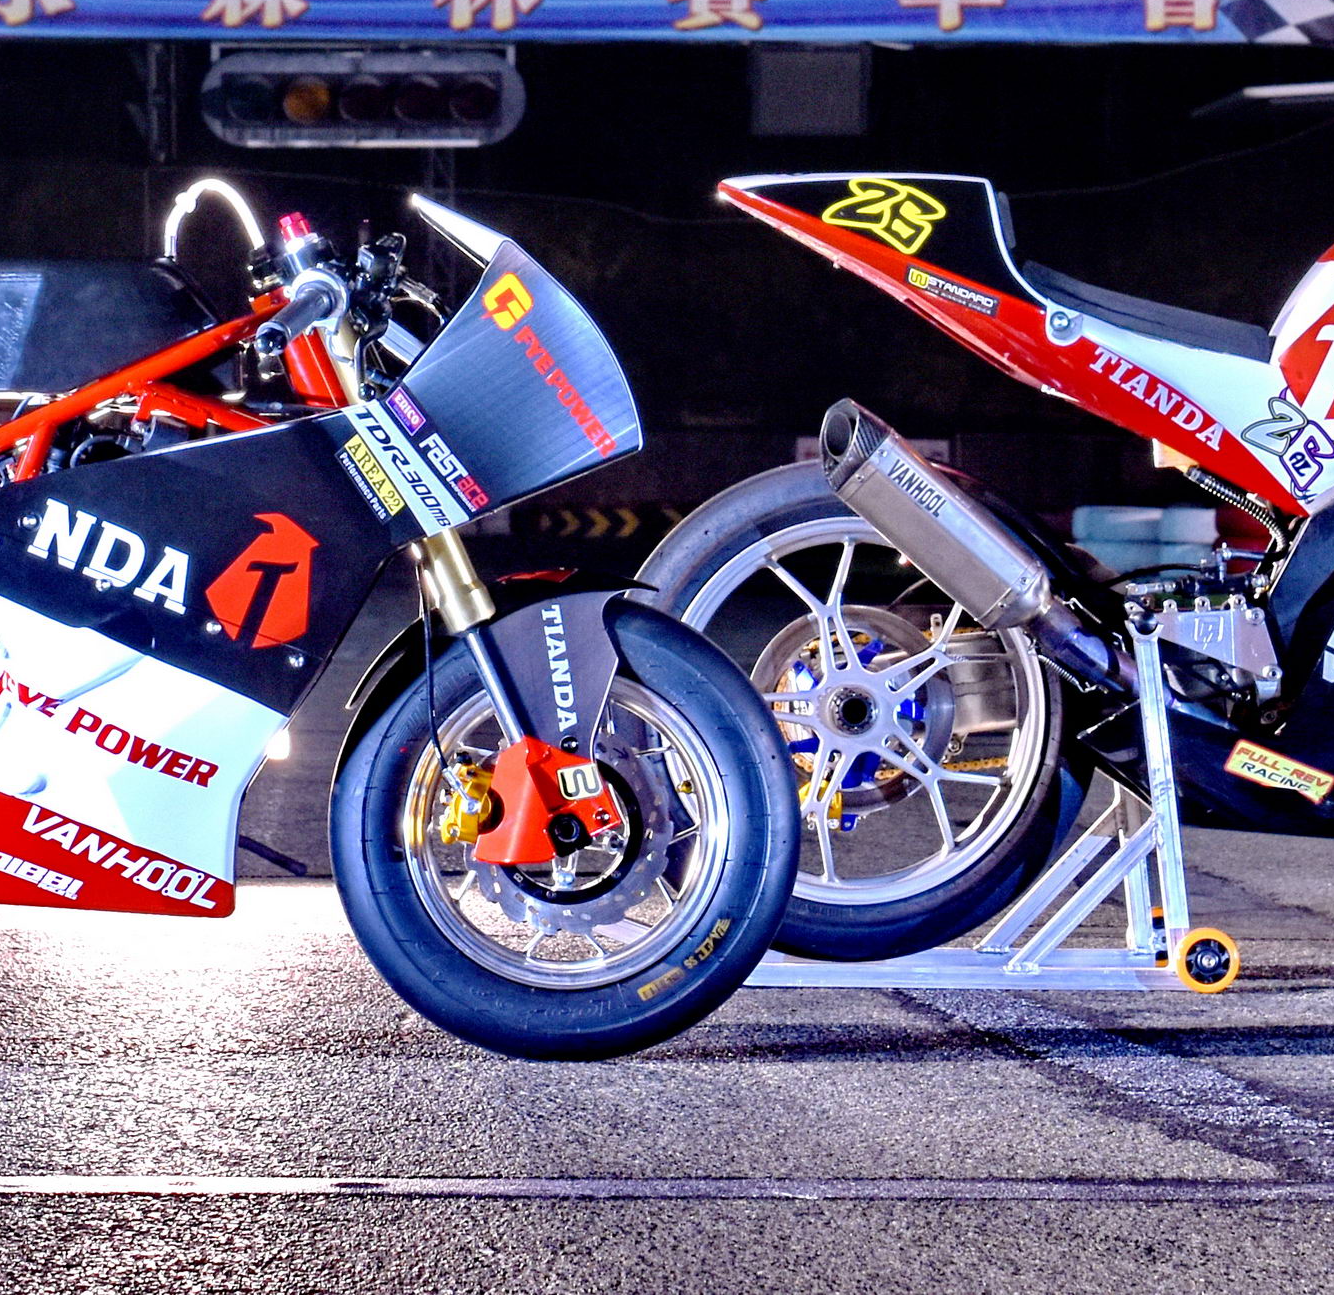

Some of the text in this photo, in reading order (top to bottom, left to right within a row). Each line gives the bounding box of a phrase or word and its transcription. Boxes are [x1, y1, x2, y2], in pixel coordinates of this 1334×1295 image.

[393, 394, 421, 426] ERICO
[1089, 346, 1225, 453] TIANDA
[339, 453, 374, 500] Performance
[348, 442, 402, 513] AREA 22
[887, 457, 948, 518] VANHOOL
[25, 497, 192, 615] NDA
[540, 604, 580, 733] TIANDA
[65, 706, 220, 788] POWER
[1235, 746, 1331, 788] FULL-REV
[1240, 761, 1312, 793] RACING
[21, 805, 221, 910] VANHOOL
